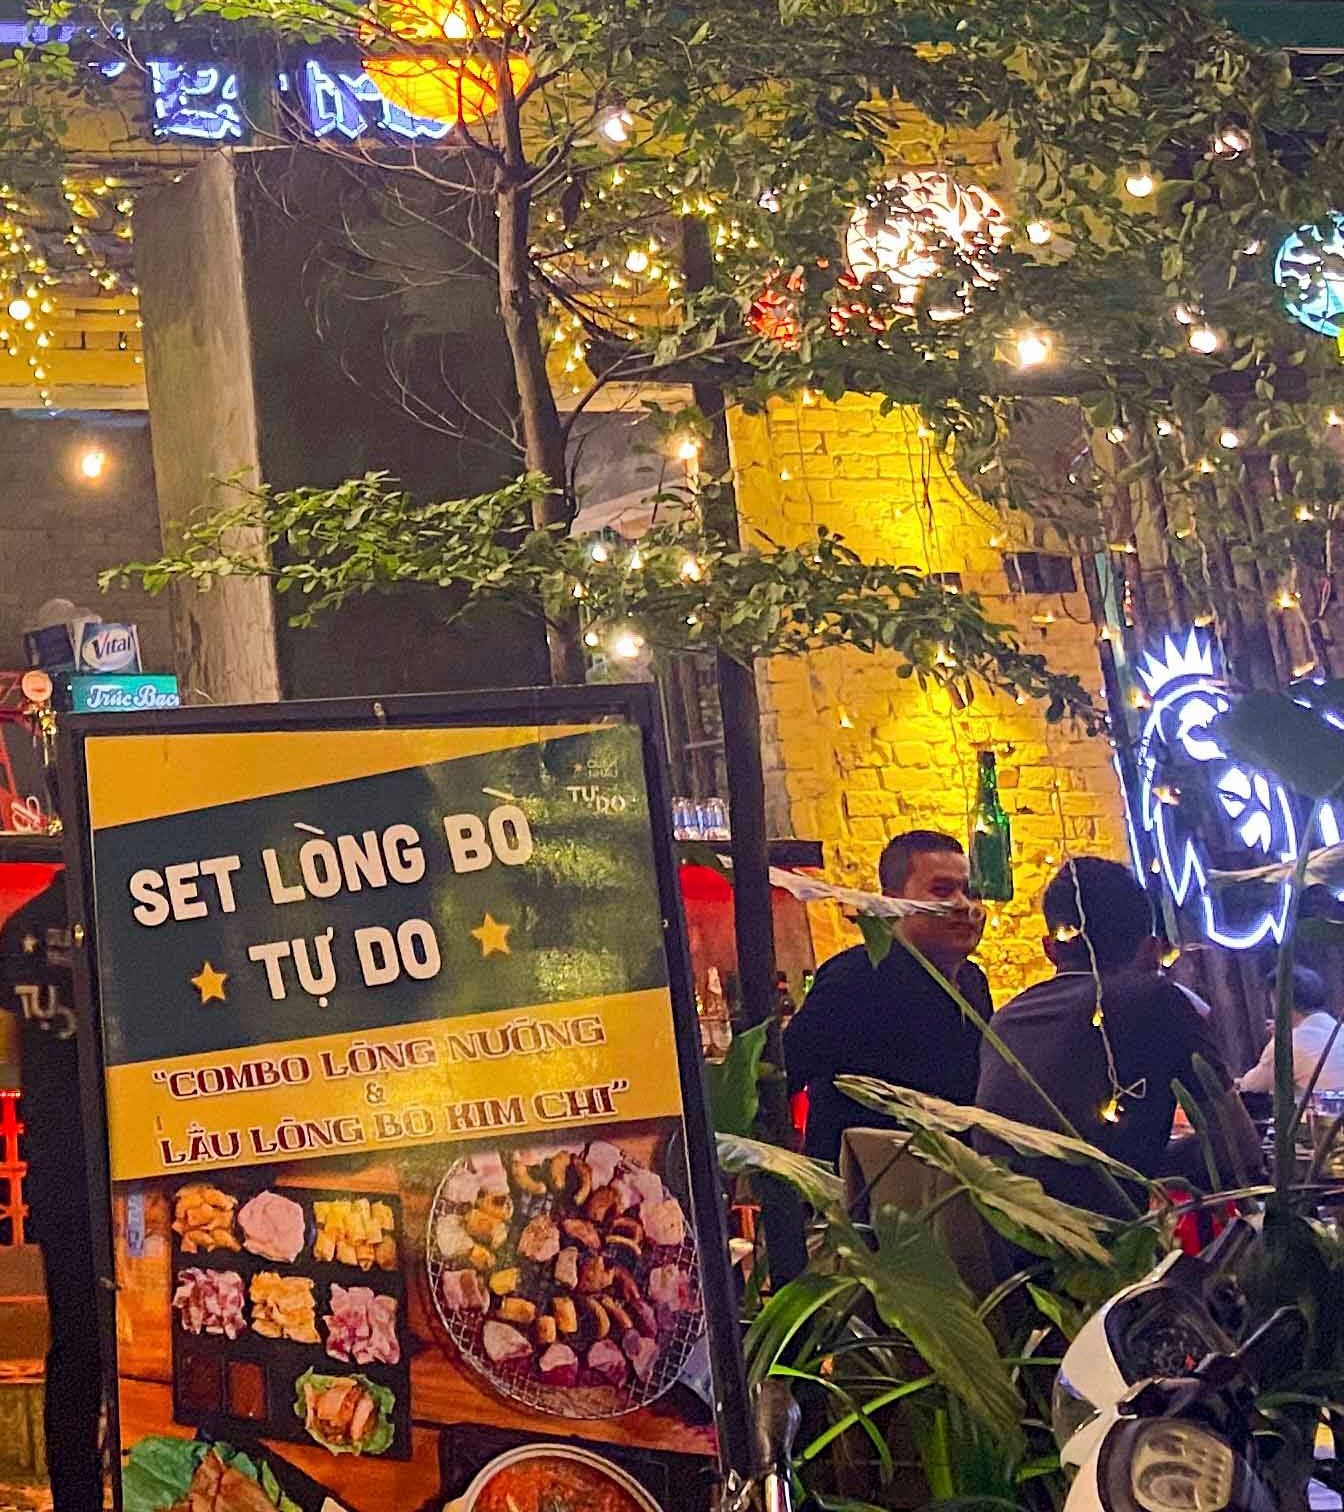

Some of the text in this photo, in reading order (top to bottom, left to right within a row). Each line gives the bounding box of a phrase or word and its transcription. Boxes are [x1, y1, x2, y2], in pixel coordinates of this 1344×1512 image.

[91, 631, 131, 660] Vital
[87, 685, 131, 708] Trúc
[128, 786, 535, 928] SET LÒNG BÒ
[248, 918, 443, 1009] TỰ DO
[364, 1081, 387, 1105] &
[444, 1095, 527, 1132] KIM
